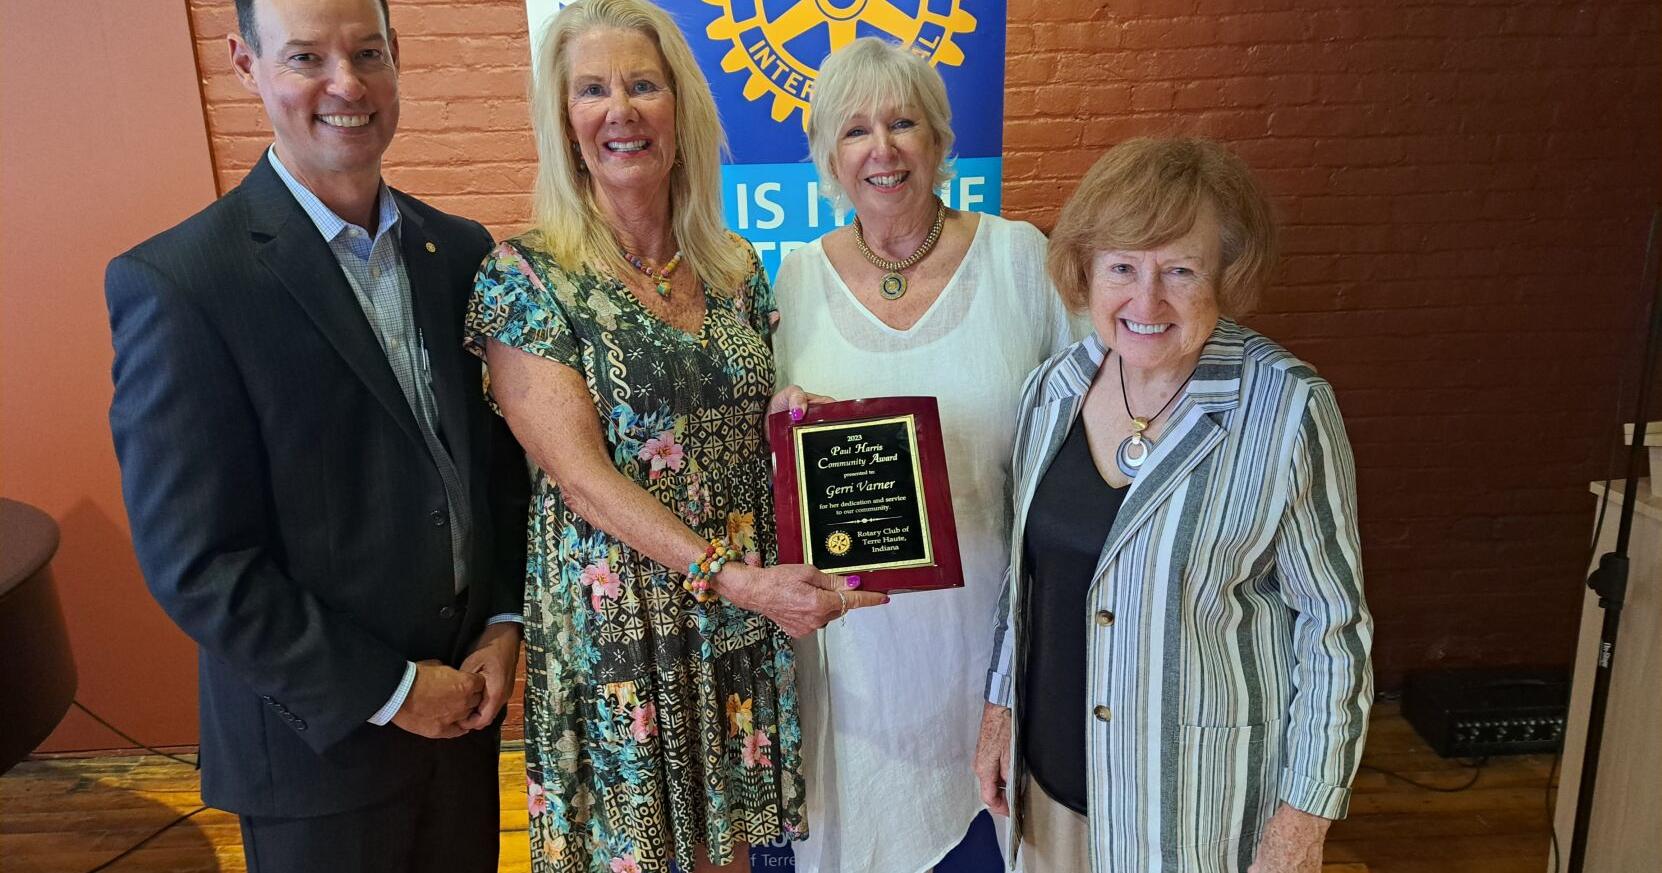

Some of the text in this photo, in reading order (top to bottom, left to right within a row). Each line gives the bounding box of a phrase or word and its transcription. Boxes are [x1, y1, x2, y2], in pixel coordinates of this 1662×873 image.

[736, 182, 785, 230] IS
[847, 434, 863, 442] 2023
[830, 442, 884, 456] Paul Harris
[817, 453, 898, 469] Community Award
[825, 480, 896, 499] Gerri Varner
[855, 505, 892, 513] community.
[857, 530, 882, 538] Rotary
[882, 527, 901, 535] Club
[862, 538, 882, 546] Terre
[871, 545, 900, 553] Indiana
[761, 853, 796, 868] Terre
